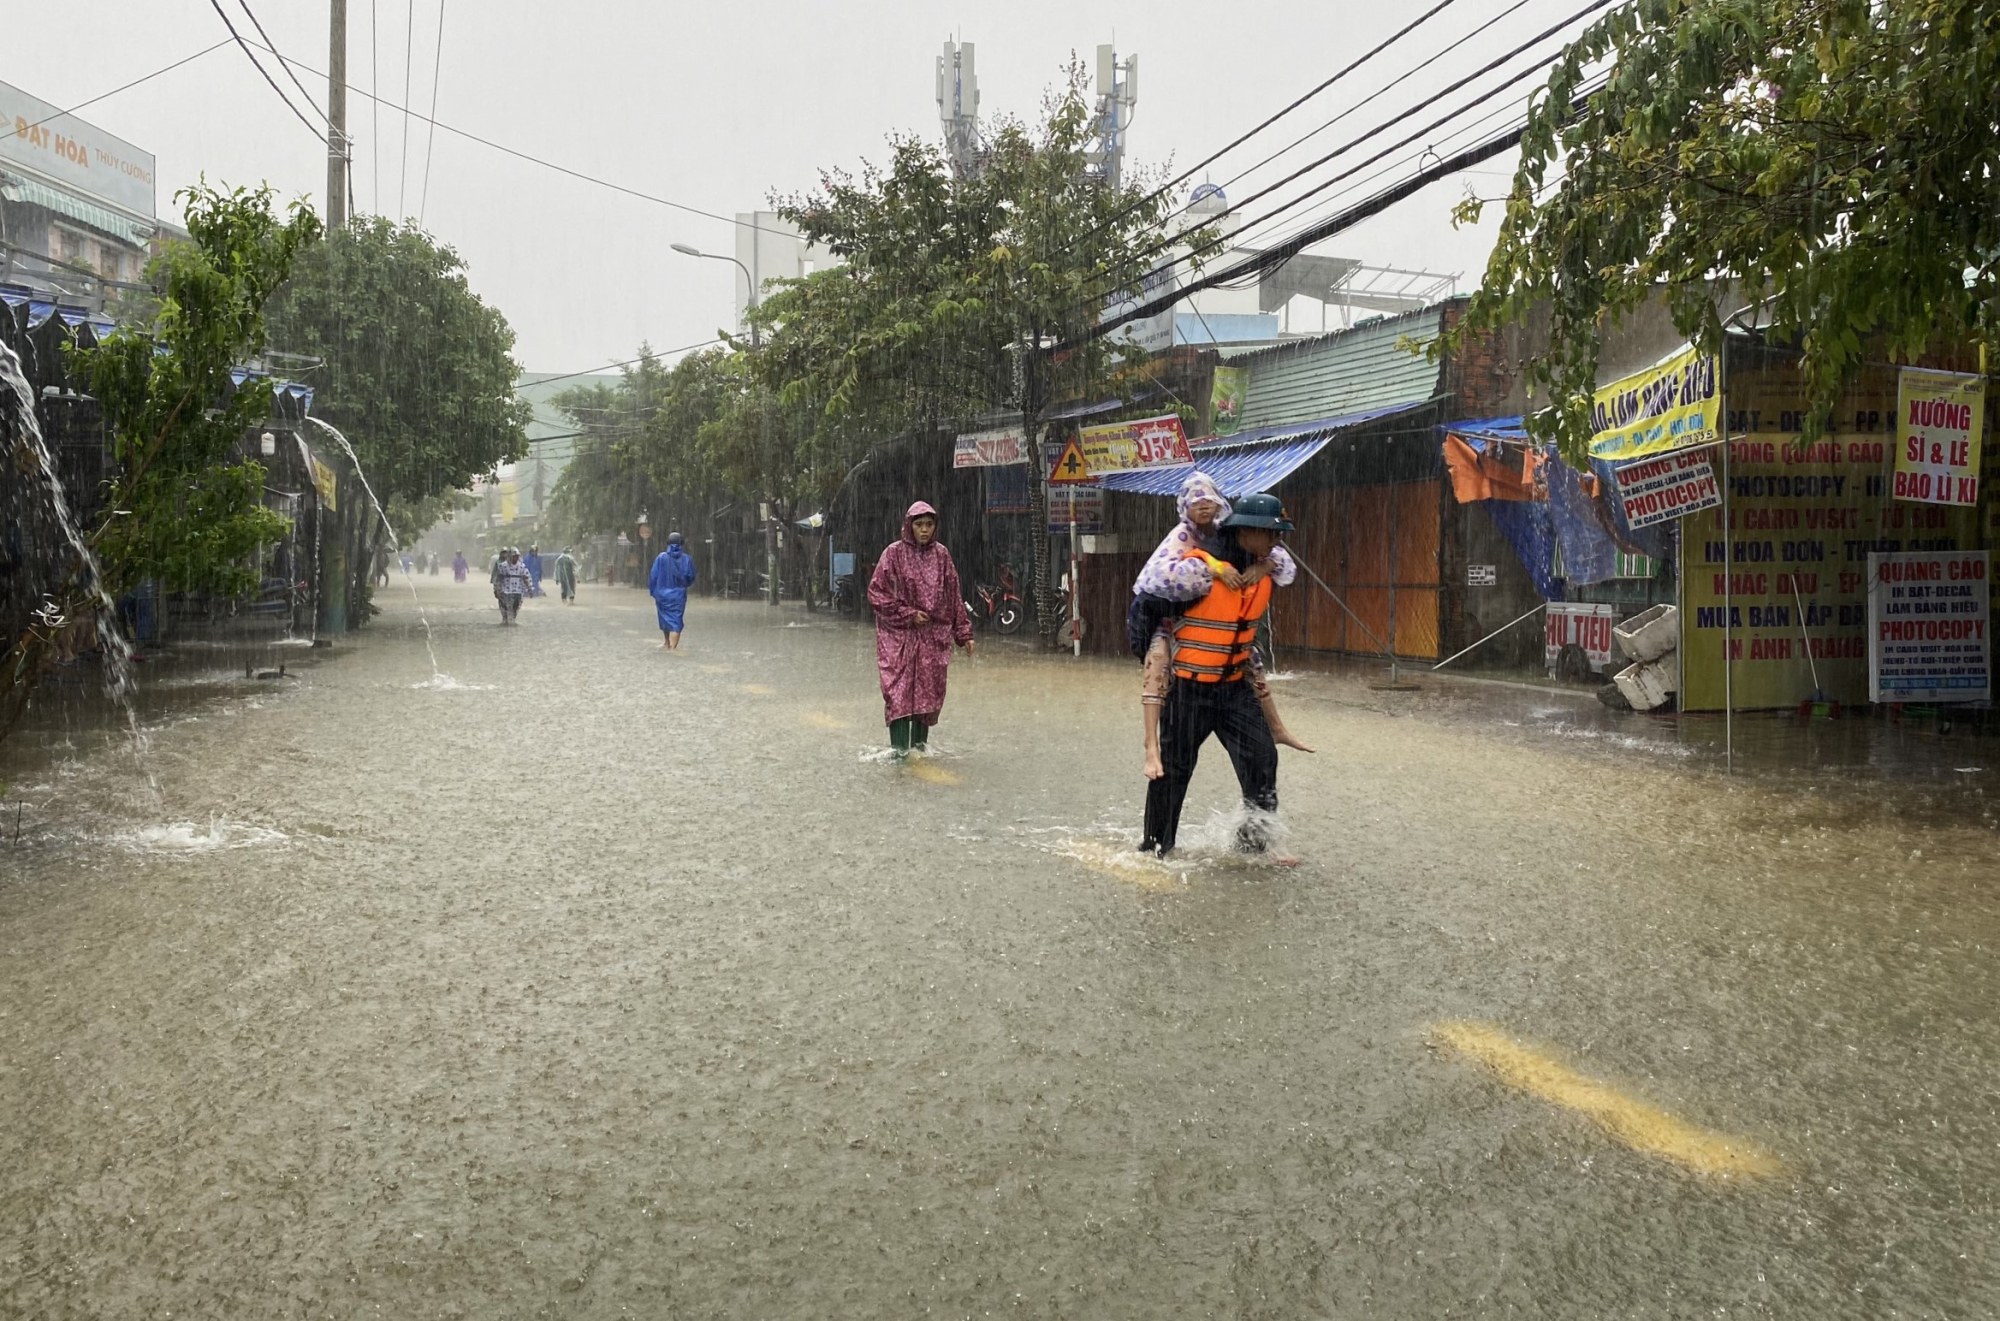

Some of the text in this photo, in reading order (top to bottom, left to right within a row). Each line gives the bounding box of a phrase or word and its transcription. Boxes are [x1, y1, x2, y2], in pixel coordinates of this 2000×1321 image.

[1909, 396, 1971, 431] XƯỞNG
[1930, 442, 1944, 464] &
[1895, 471, 1931, 499] BAO
[1625, 476, 1715, 519] PHOTOCOPY
[1743, 508, 1799, 530] CARD
[1805, 508, 1860, 530] VISIT
[1892, 586, 1904, 598] IN
[1879, 620, 1985, 641] PHOTOCOPY
